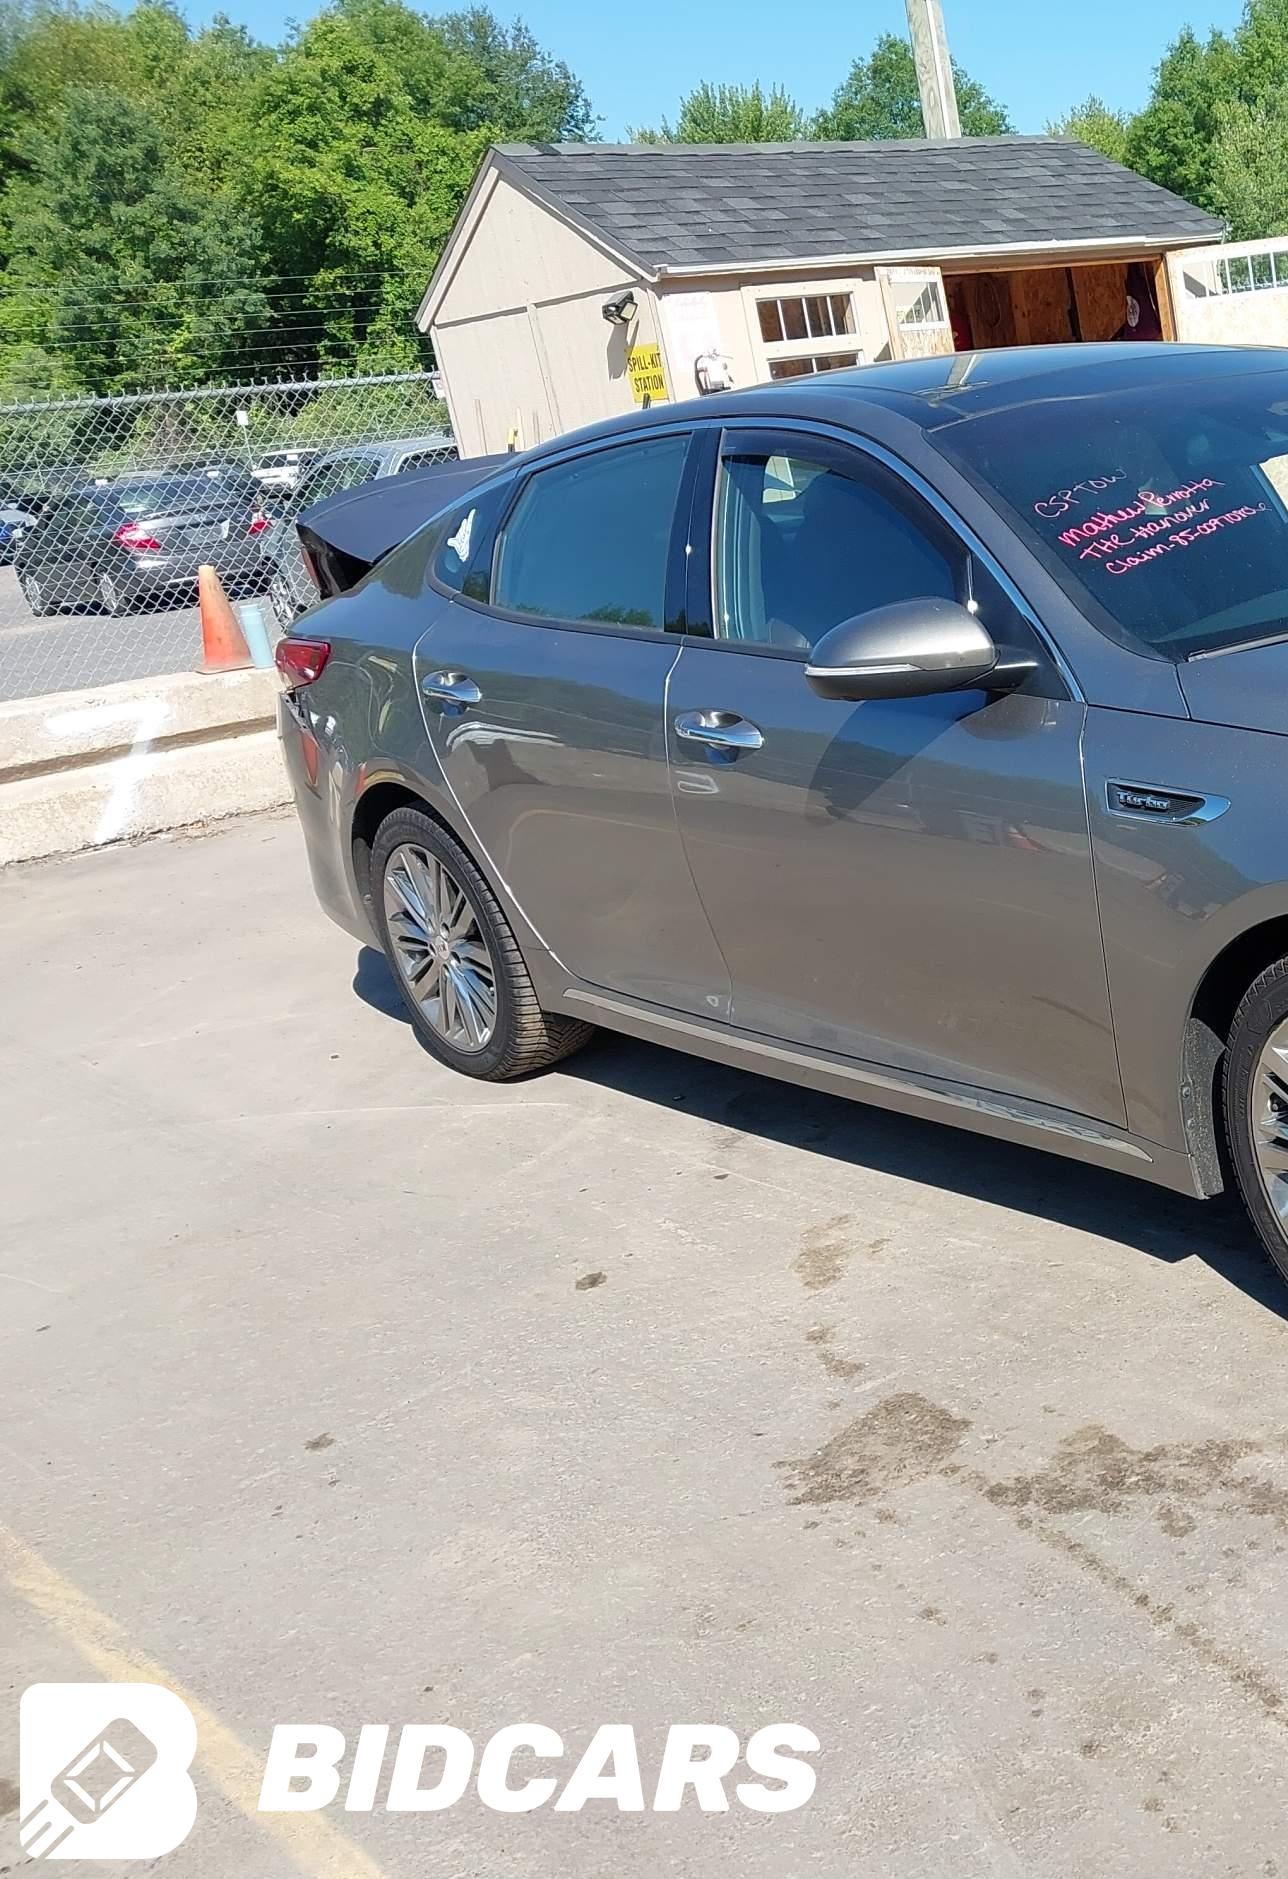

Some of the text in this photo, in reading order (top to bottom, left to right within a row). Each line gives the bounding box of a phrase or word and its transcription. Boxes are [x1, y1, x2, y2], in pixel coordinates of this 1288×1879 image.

[627, 352, 661, 373] SPILL-KIT
[634, 375, 664, 392] STATION
[1116, 791, 1170, 810] Turbo
